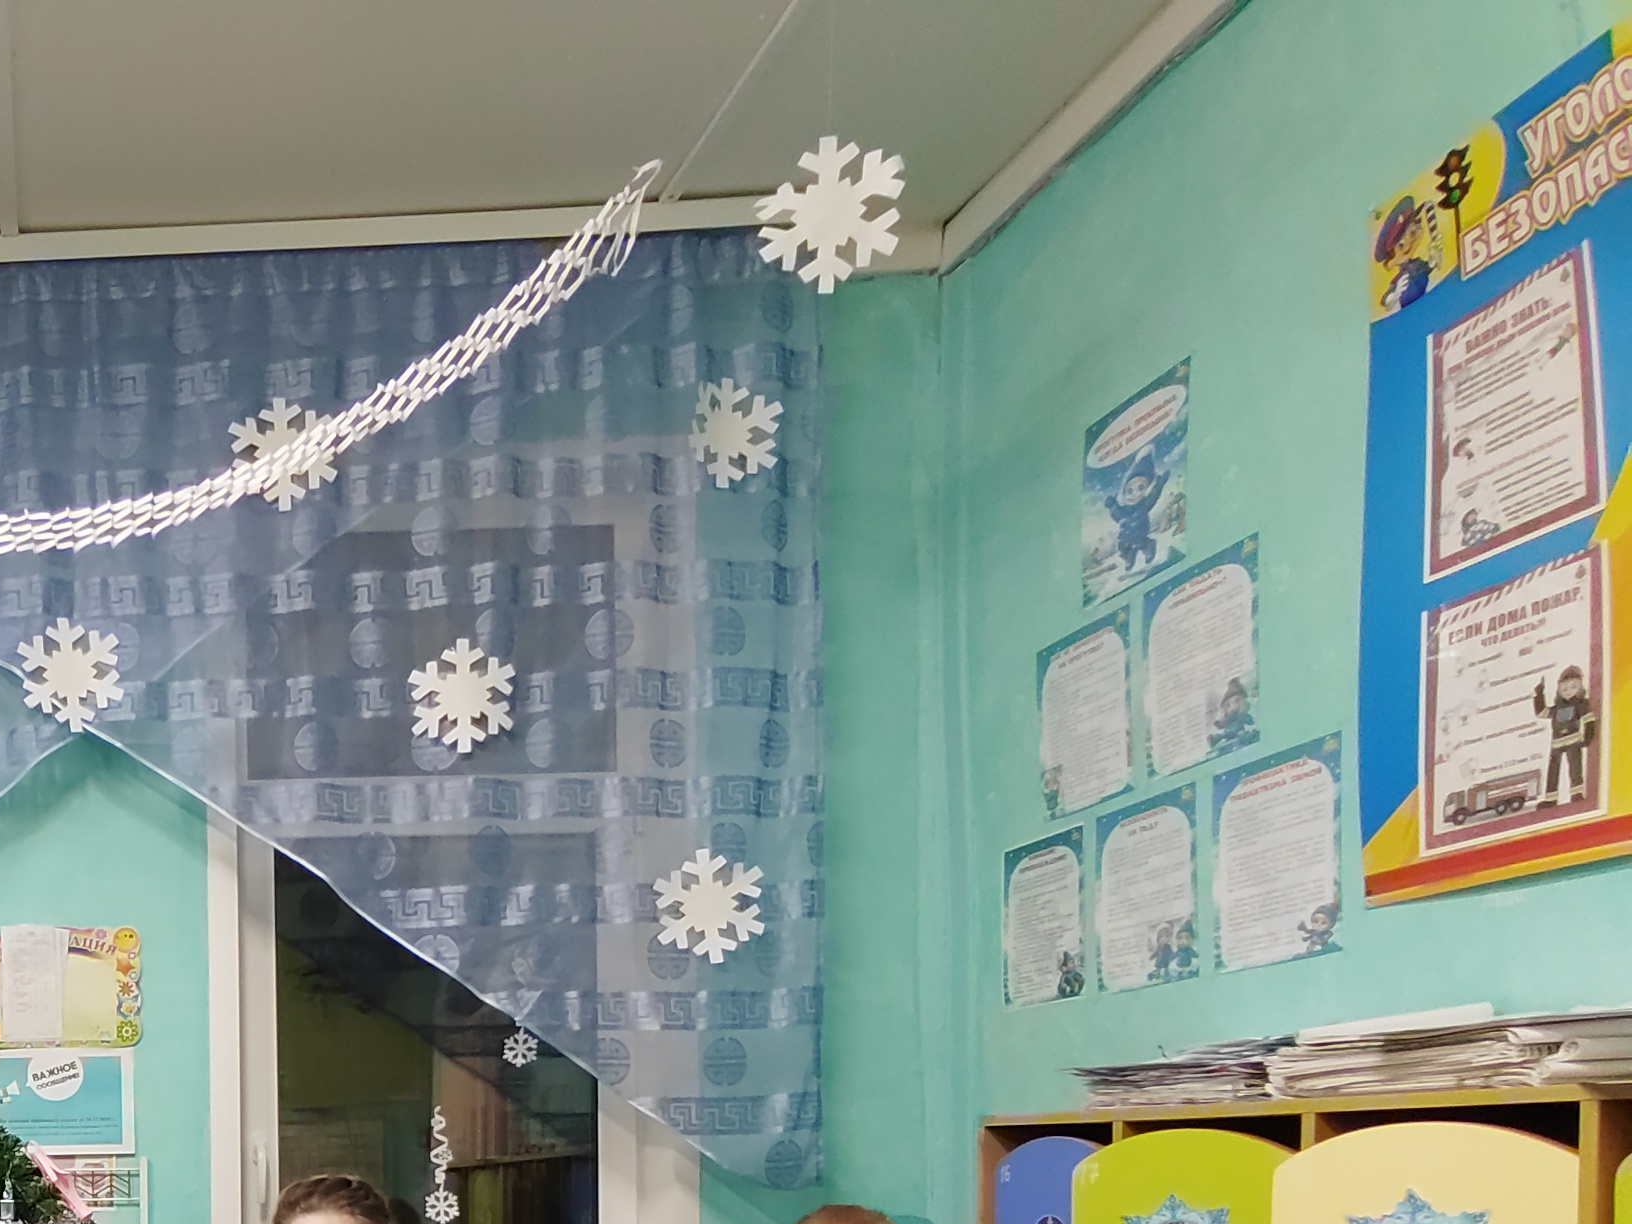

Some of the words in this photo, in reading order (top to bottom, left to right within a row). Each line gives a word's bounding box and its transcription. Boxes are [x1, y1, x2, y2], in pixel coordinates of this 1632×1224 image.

[1463, 126, 1632, 274] БЕЗОПАС
[1449, 621, 1483, 645] ЕСЛИ
[1487, 605, 1527, 632] ДОМА
[1481, 635, 1499, 647] ЧТО
[31, 1060, 78, 1082] ВАЖНОЕ
